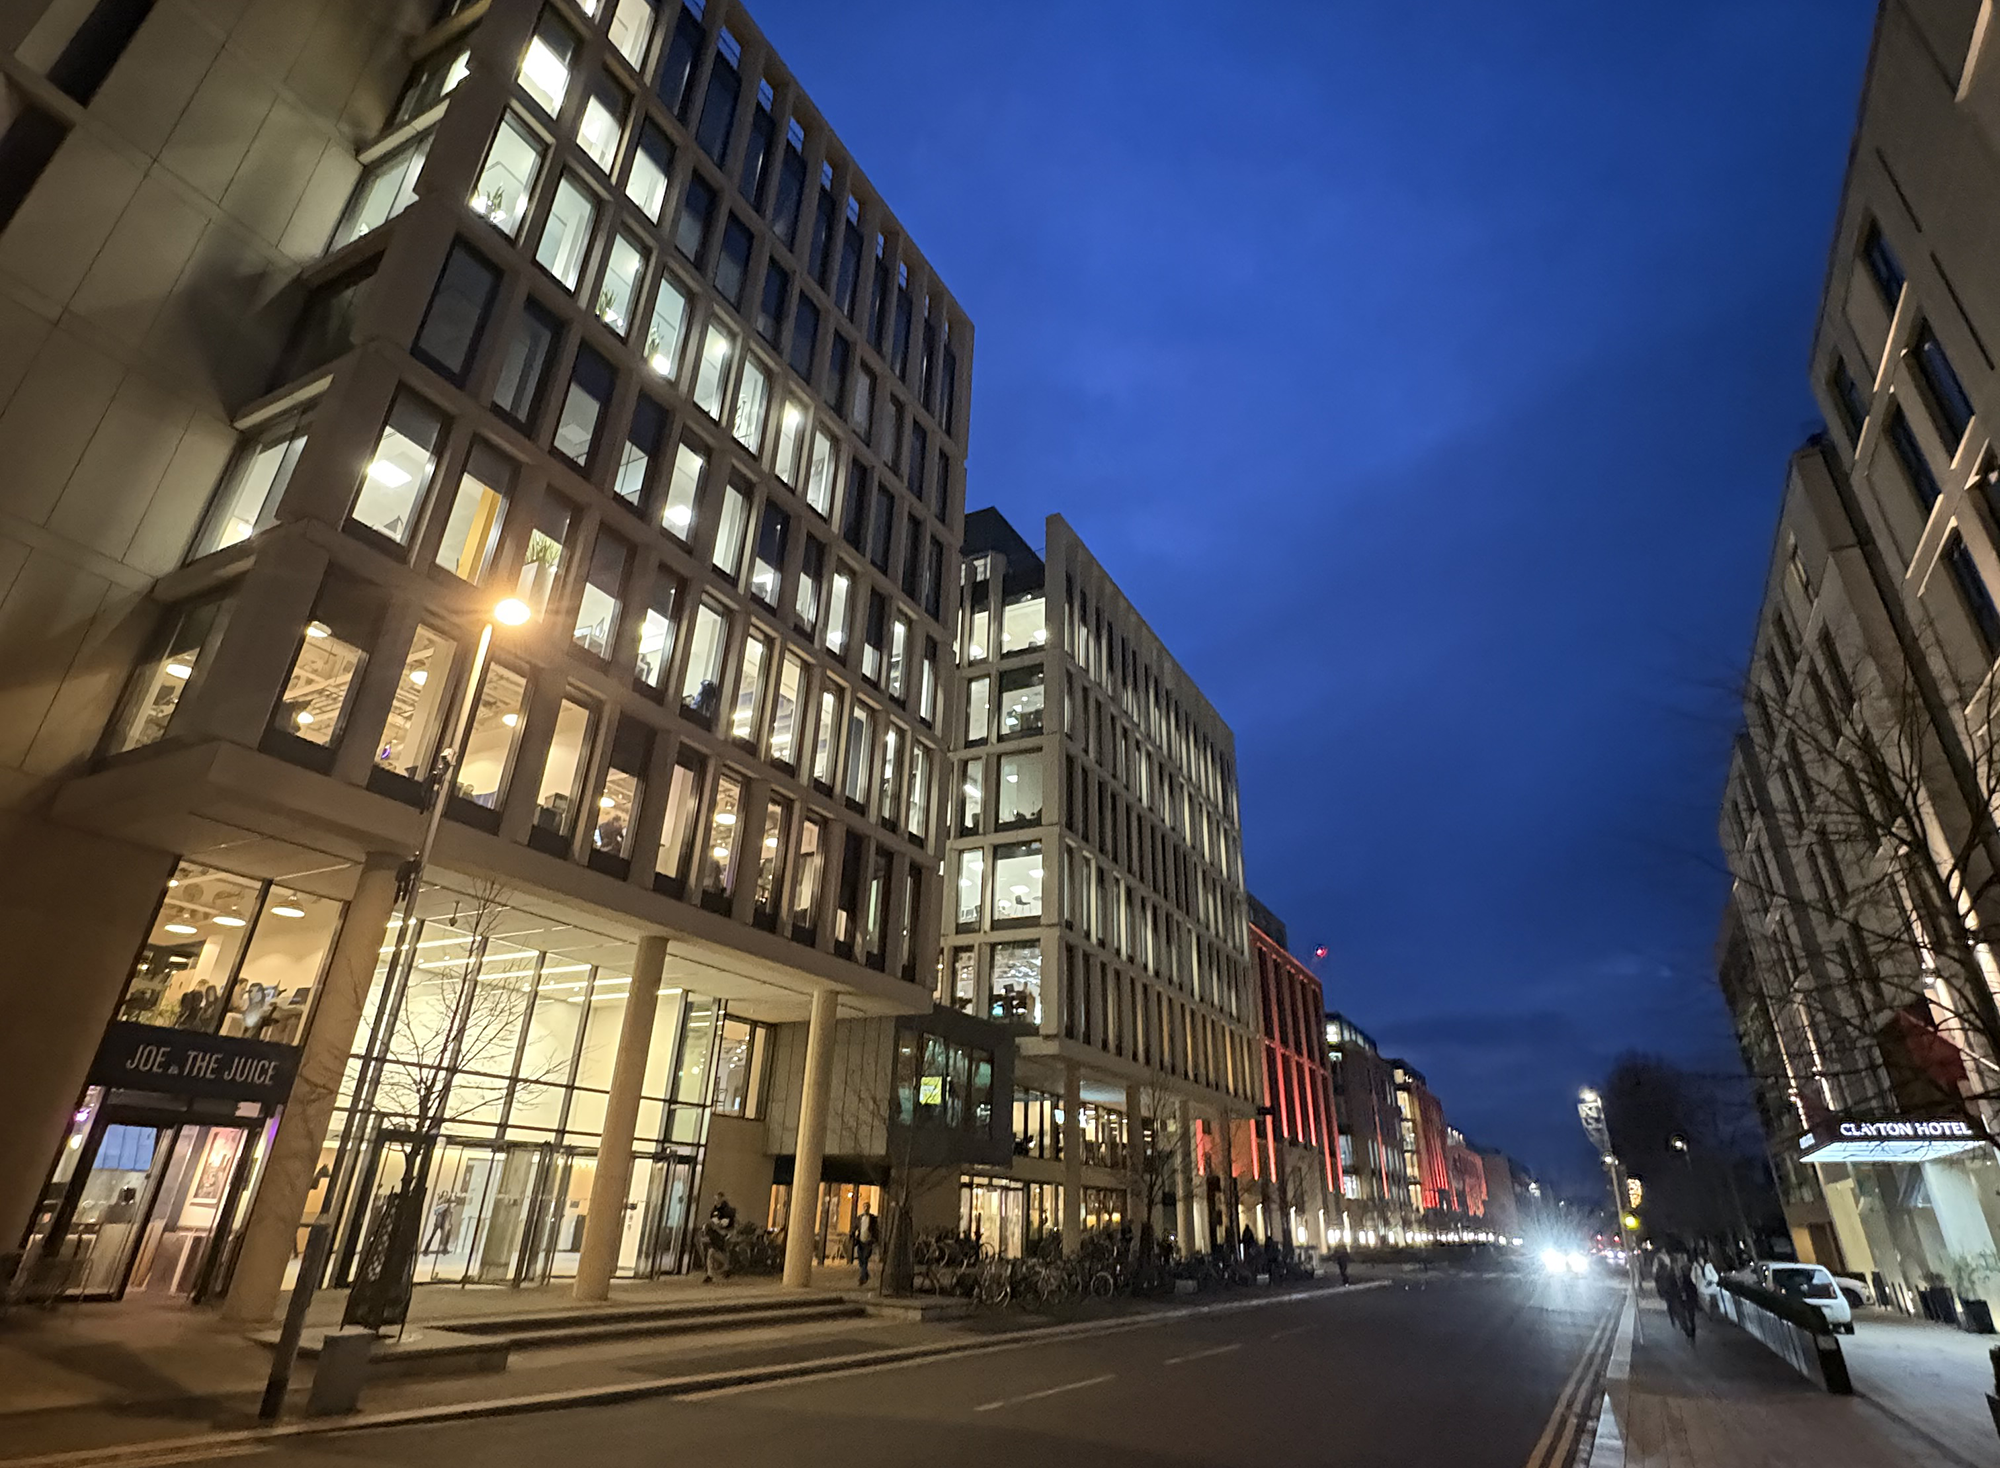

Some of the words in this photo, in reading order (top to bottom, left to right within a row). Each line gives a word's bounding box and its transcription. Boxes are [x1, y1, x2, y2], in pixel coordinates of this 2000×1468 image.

[126, 1044, 171, 1073] JOE
[183, 1050, 223, 1079] THE
[224, 1056, 279, 1085] JUICE
[1840, 1122, 1914, 1136] CLAYTON
[1915, 1121, 1973, 1135] HOTEL
